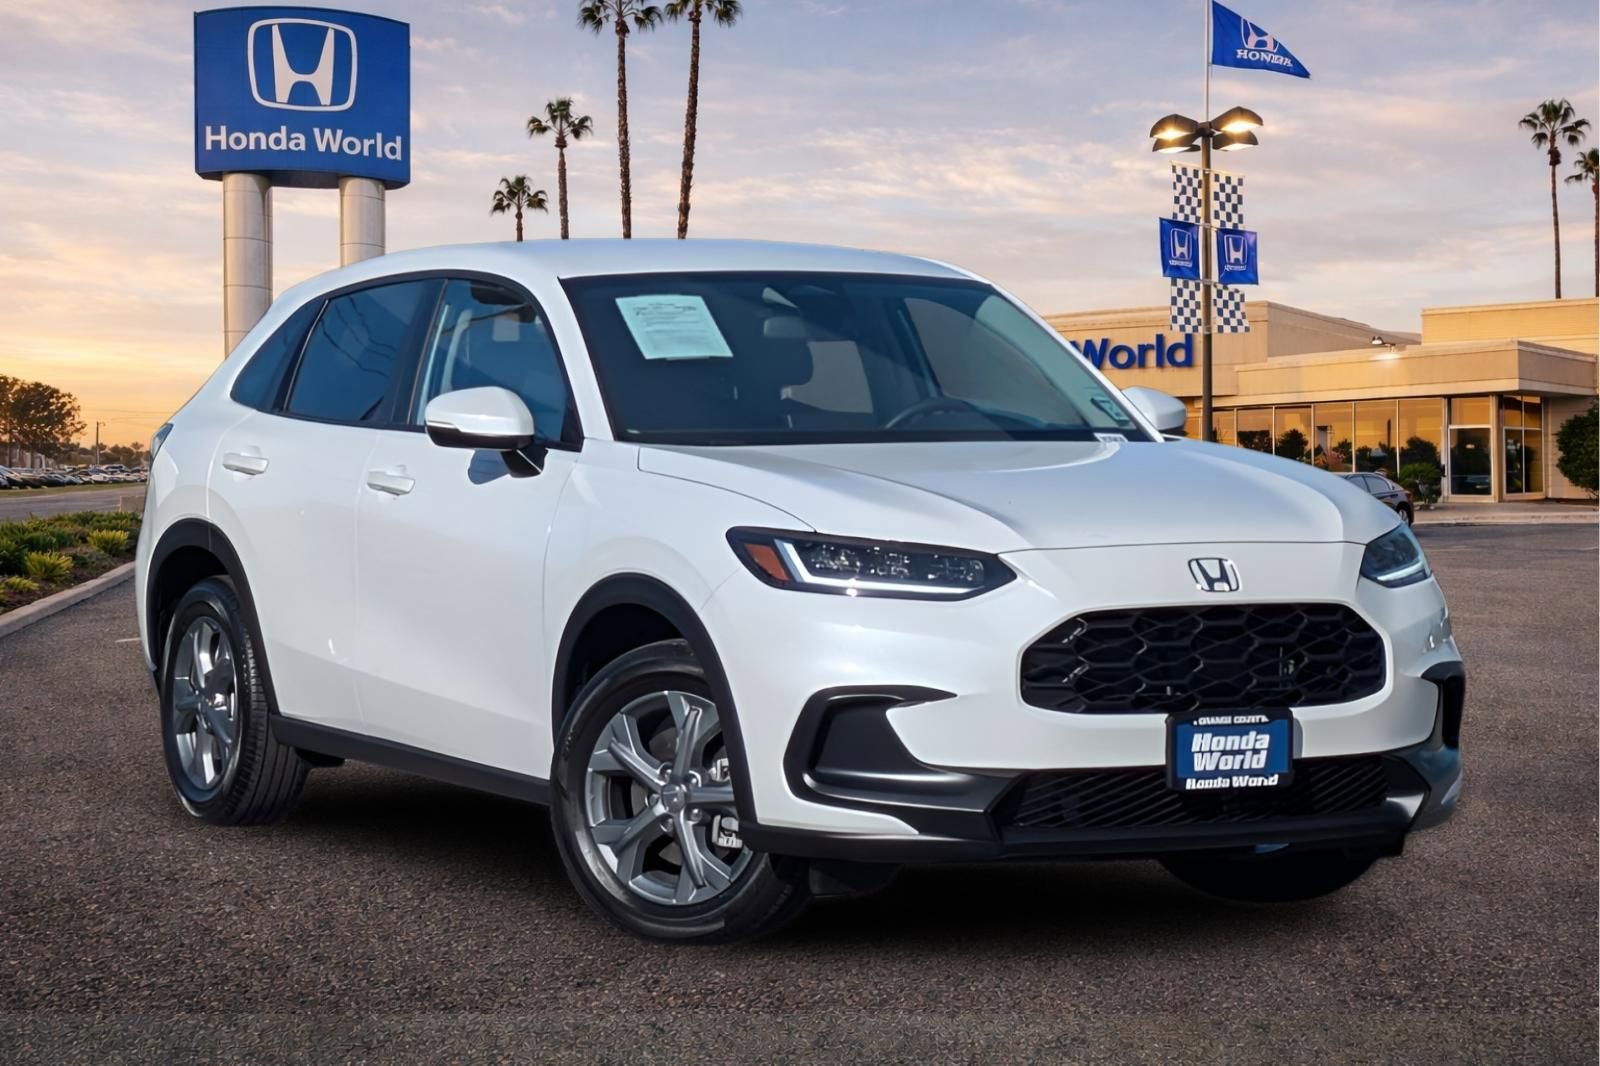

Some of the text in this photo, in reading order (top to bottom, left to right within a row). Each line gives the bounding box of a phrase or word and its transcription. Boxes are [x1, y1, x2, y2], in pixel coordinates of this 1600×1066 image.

[205, 125, 402, 161] Honda World
[1070, 333, 1194, 370] World
[1191, 731, 1270, 752] Honda
[1193, 750, 1268, 772] World
[1186, 777, 1230, 790] Honda
